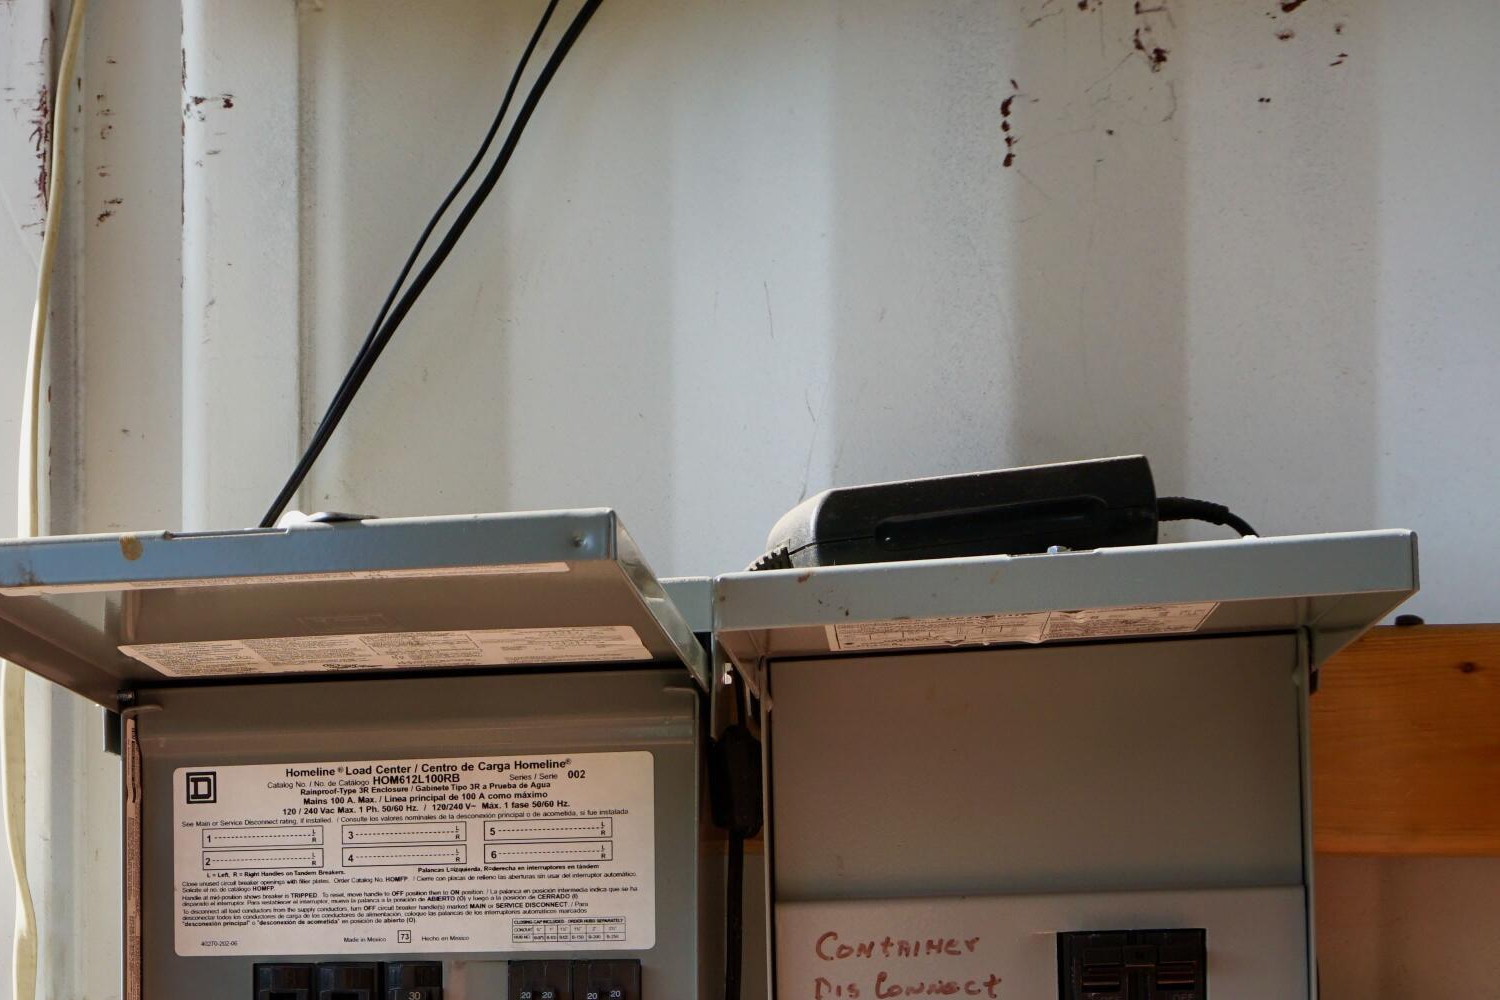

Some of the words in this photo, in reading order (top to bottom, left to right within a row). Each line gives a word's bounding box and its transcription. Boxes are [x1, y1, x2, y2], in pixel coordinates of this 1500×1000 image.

[345, 766, 372, 775] Load
[375, 765, 411, 774] Center
[421, 763, 457, 773] Centro
[460, 763, 474, 772] de
[477, 761, 510, 773] Carga
[568, 770, 585, 778] 002
[301, 787, 356, 797] Rainproof-Type
[415, 784, 449, 792] Gabinete
[451, 784, 467, 792] Tipo
[488, 782, 517, 790] Prueba
[530, 782, 550, 790] Agua
[331, 796, 344, 804] 100
[409, 794, 445, 803] principal
[432, 802, 463, 810] 120/240
[531, 800, 554, 808] 50/60
[348, 831, 354, 839] 3
[490, 828, 496, 836] 5
[206, 835, 211, 843] 1
[348, 854, 354, 863] 4
[490, 851, 497, 859] 6
[205, 858, 211, 866] 2
[408, 992, 420, 1000] 30
